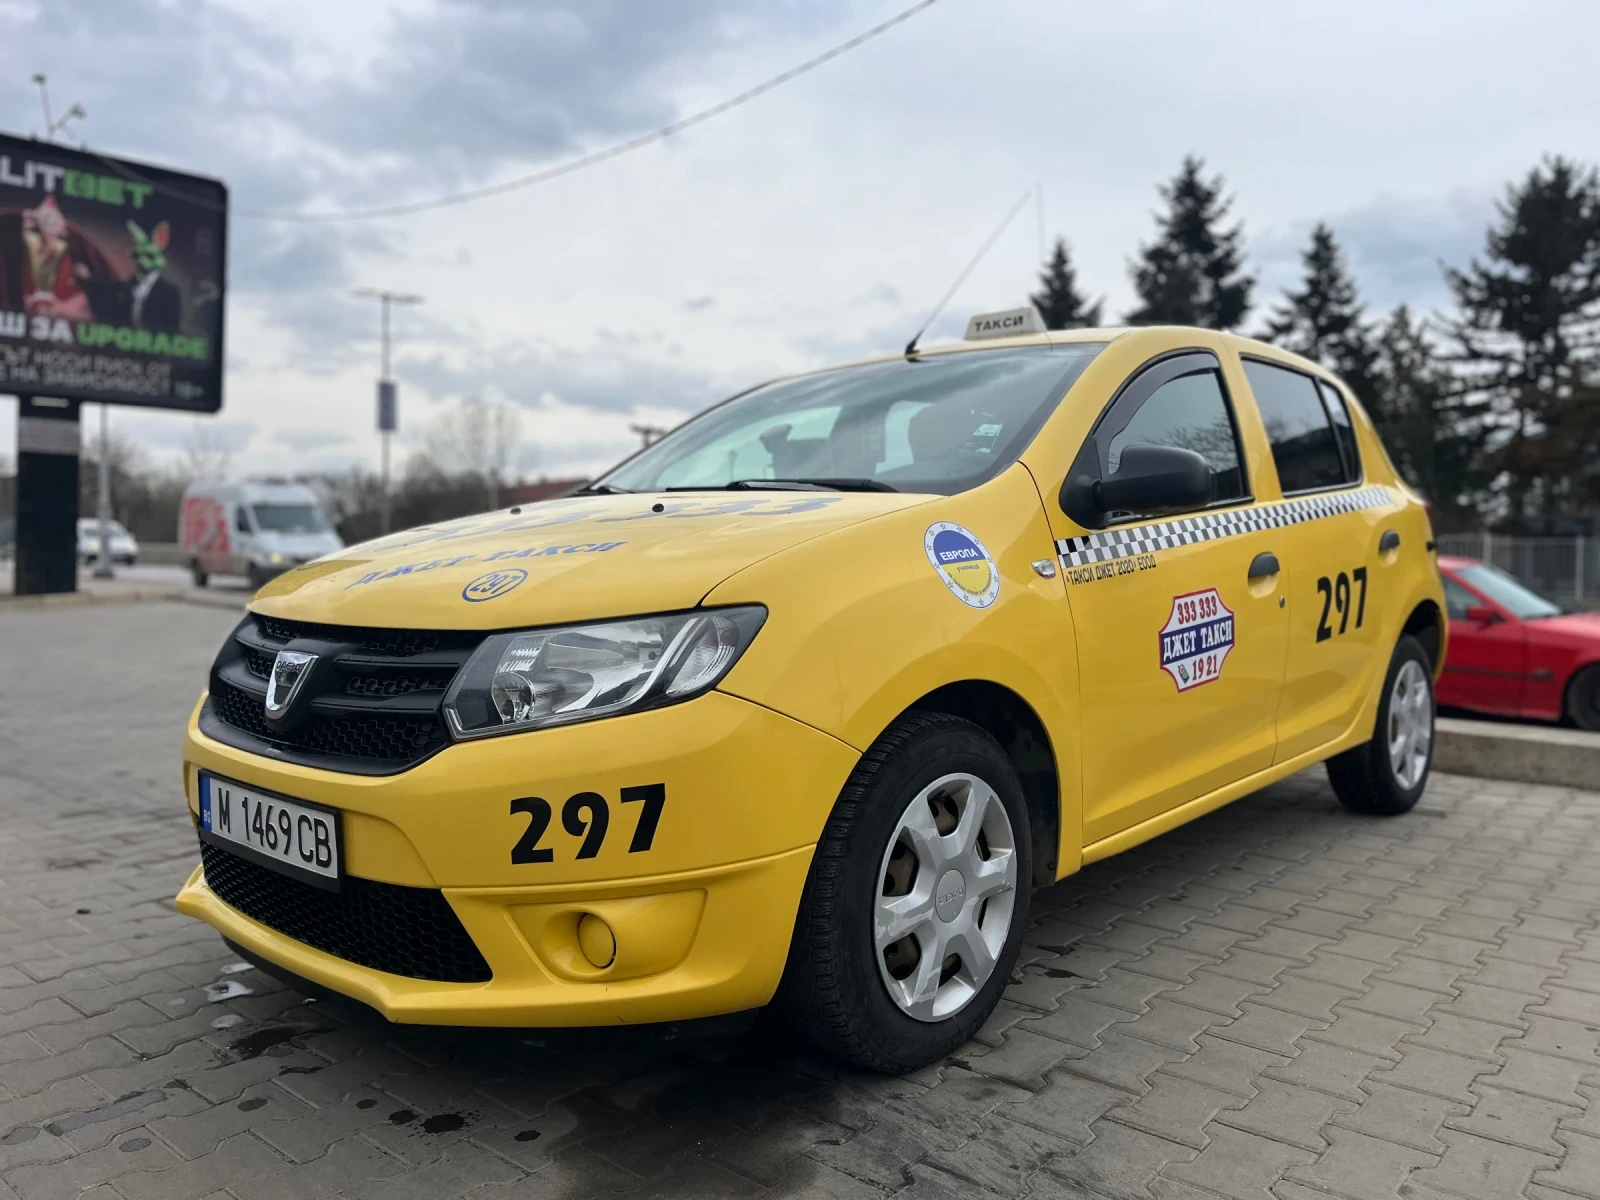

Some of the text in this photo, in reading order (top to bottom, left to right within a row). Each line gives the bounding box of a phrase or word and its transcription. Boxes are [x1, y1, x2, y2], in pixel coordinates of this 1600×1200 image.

[30, 315, 74, 344] ЗА
[77, 322, 208, 360] UPGRADE
[975, 315, 1024, 332] ТАКСИ
[343, 541, 629, 591] ДЖЕТ ТАКСИ
[939, 548, 979, 561] ЕВРОПА
[469, 573, 522, 595] 297
[1095, 562, 1116, 580] ДЖЕТ
[1177, 595, 1218, 625] 333 333
[1315, 565, 1368, 644] 297
[1163, 620, 1232, 662] ДЖЕТ ТАКСИ
[275, 660, 301, 673] DACIA
[1192, 653, 1218, 681] 19 21
[203, 809, 211, 823] BG
[218, 787, 332, 868] M 1469 CB
[510, 783, 666, 865] 297
